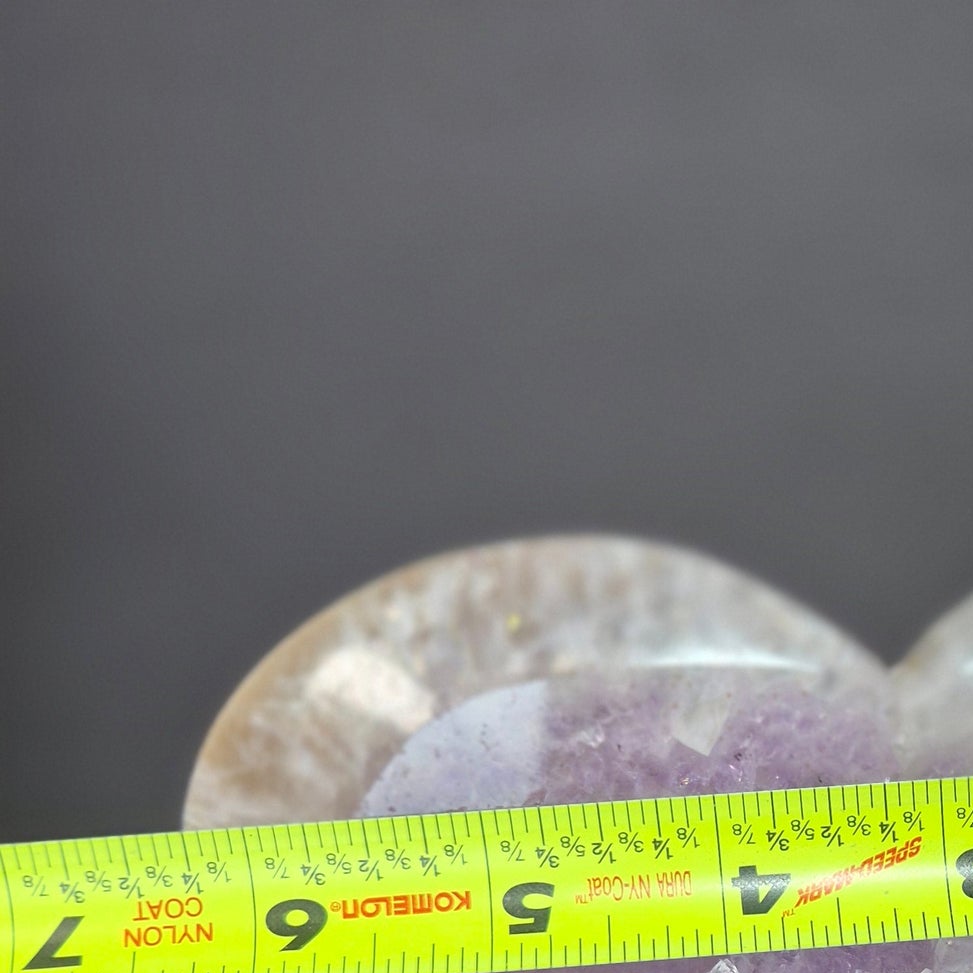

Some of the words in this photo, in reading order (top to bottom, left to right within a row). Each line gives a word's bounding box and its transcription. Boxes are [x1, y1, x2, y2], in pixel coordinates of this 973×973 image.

[133, 897, 202, 921] COAT
[501, 882, 559, 936] 5
[656, 871, 694, 899] DURA
[729, 865, 793, 915] 4
[22, 916, 84, 970] 7
[125, 923, 213, 947] NYLON
[266, 899, 328, 952] 6
